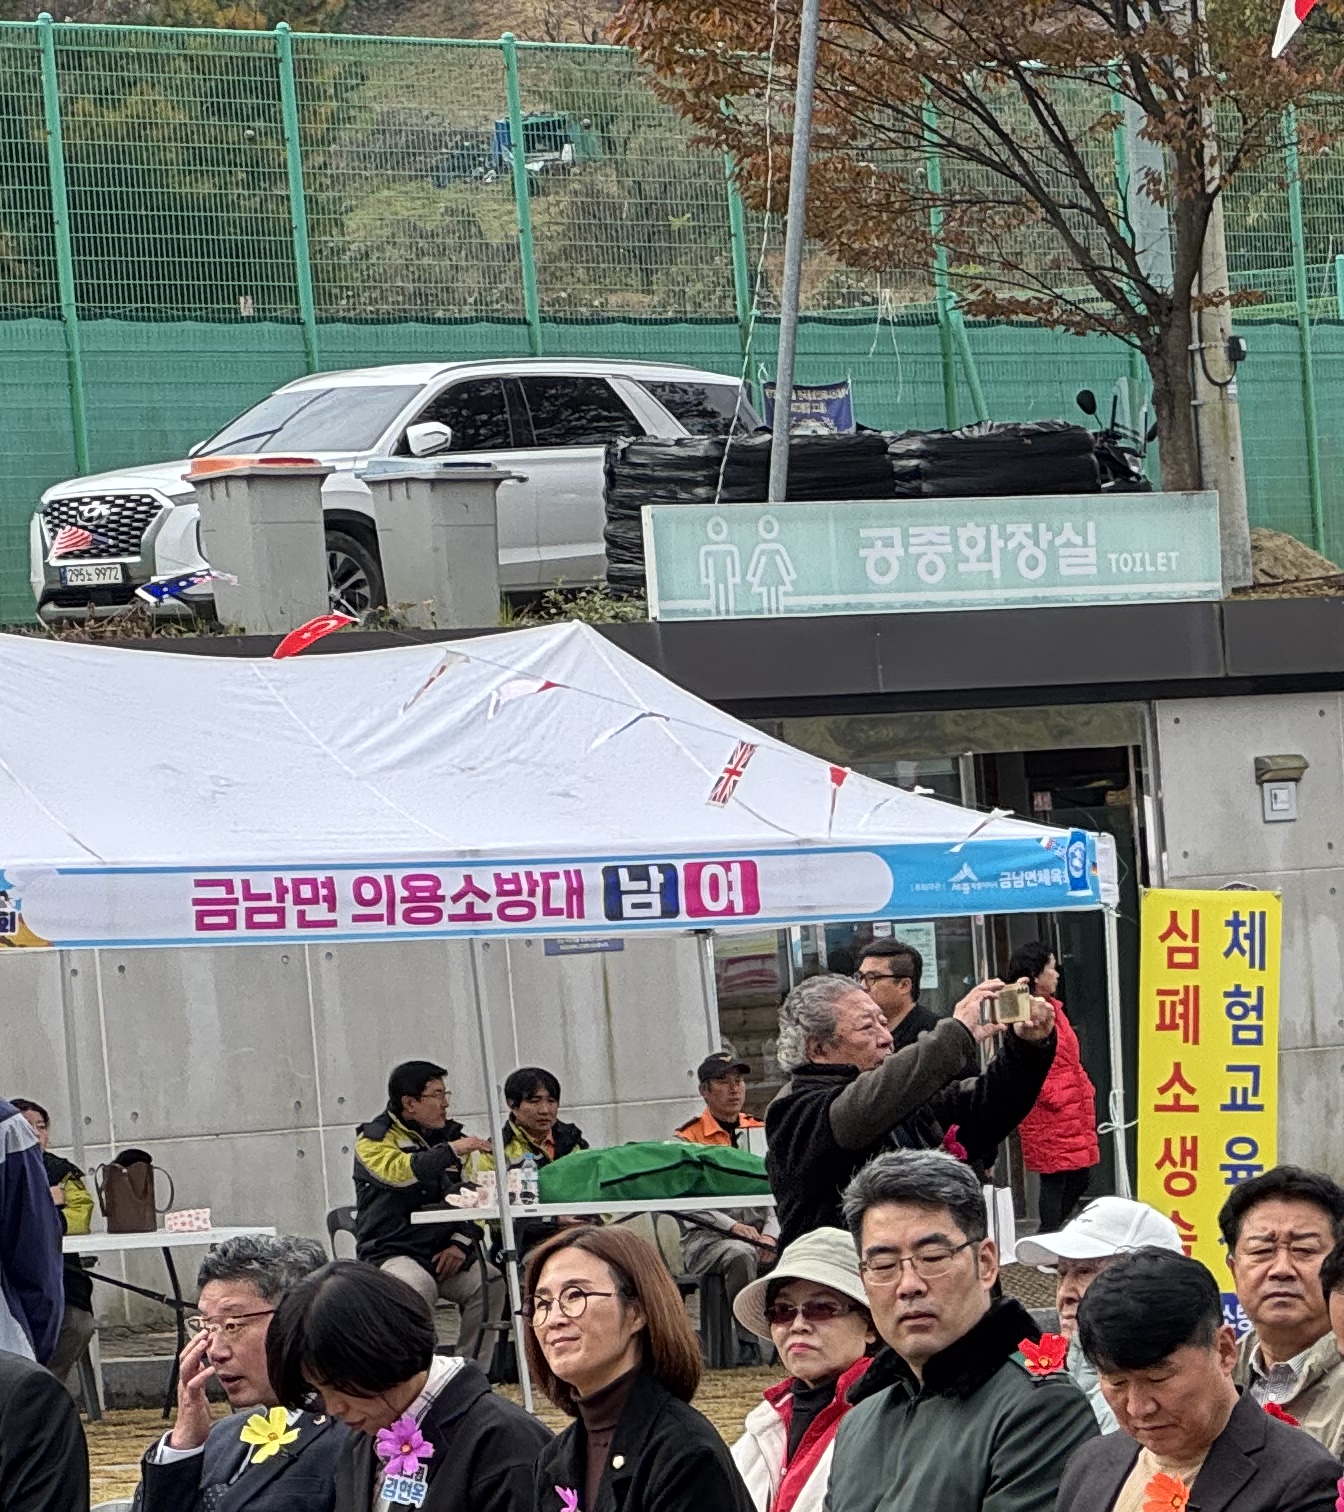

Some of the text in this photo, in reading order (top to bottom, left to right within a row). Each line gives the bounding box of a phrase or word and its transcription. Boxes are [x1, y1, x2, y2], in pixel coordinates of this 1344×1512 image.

[94, 566, 119, 580] 9972
[859, 520, 1179, 585] 공중화장실 TOILET
[192, 863, 743, 931] 금남면 의용소방대 남 여
[1219, 910, 1267, 1245] 체험교육
[383, 1477, 425, 1504] 김현옥
